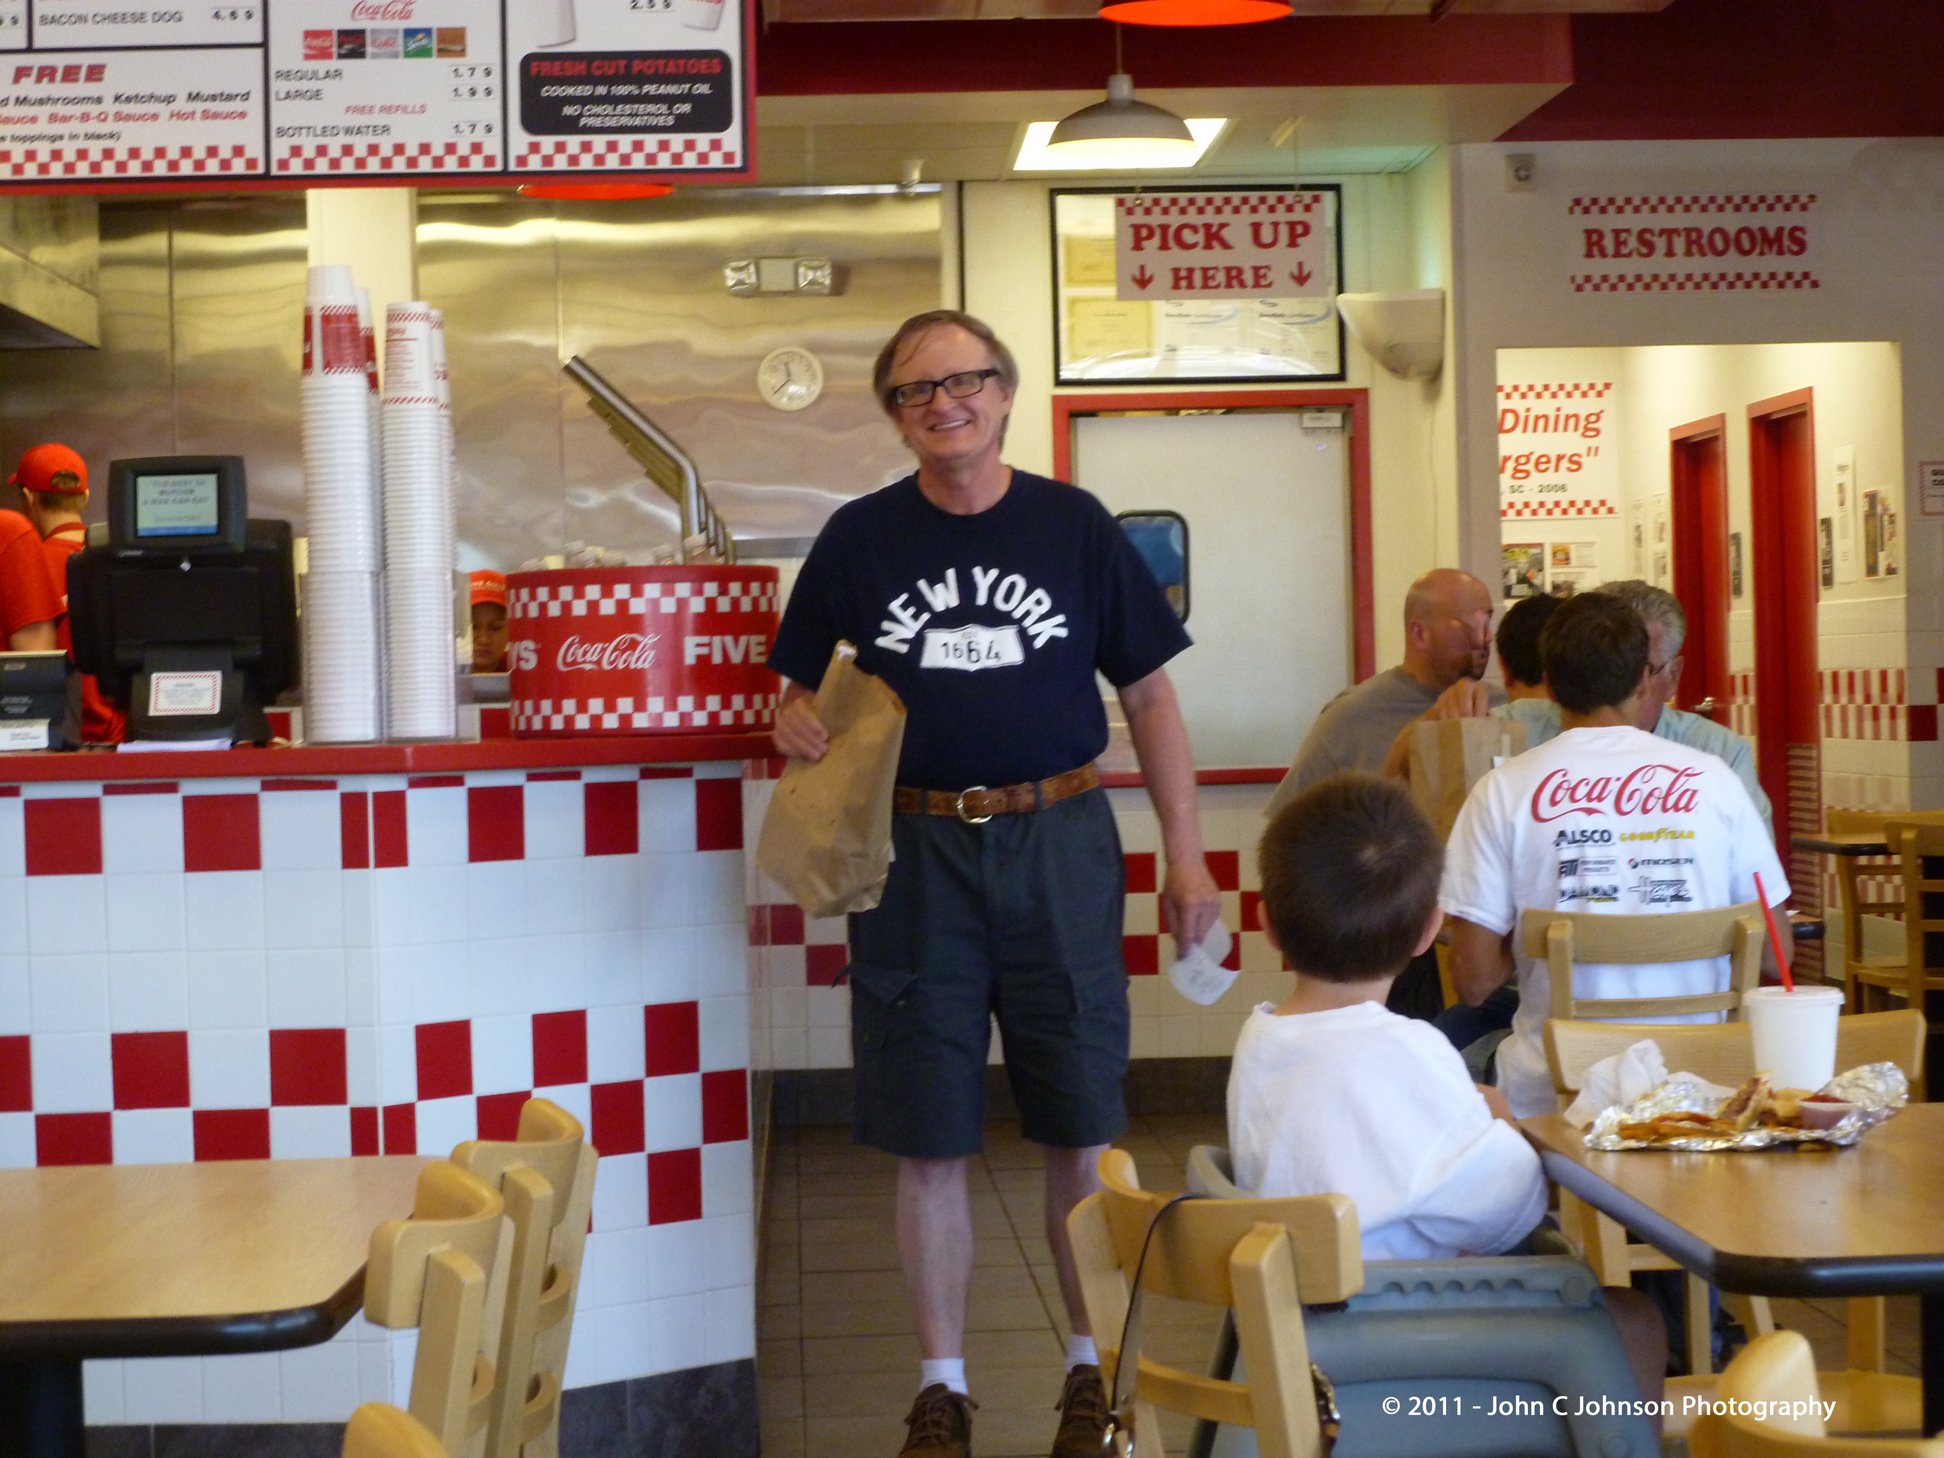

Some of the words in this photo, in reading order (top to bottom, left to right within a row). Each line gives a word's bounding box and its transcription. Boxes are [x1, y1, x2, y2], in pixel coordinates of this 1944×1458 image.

[39, 13, 88, 26] BACON
[92, 11, 147, 25] CHEESE
[151, 10, 183, 23] DOG
[351, 0, 417, 21] Coca-Cola
[12, 63, 107, 85] FREE
[275, 68, 342, 82] REGULAR
[530, 60, 587, 76] FRESH
[591, 60, 628, 75] CUT
[632, 58, 723, 75] POTATOES
[14, 94, 103, 107] Mushrooms
[113, 91, 177, 106] Ketchup
[186, 90, 251, 103] Mustard
[275, 88, 324, 101] LARGE
[541, 85, 593, 97] COOKED
[594, 84, 608, 96] IN
[610, 84, 640, 96] 100%
[641, 83, 690, 95] PEANUT
[692, 83, 713, 95] OIL
[48, 111, 109, 124] Bar-B-Q
[113, 110, 160, 123] Sauce
[169, 109, 196, 121] Hot
[200, 109, 248, 121] Sauce
[345, 104, 375, 115] FREE
[379, 103, 427, 115] REFILLS
[562, 105, 582, 116] NO
[583, 103, 670, 116] CHOLESTEROL
[673, 103, 692, 114] OR
[579, 115, 675, 127] PRESERVATIVES
[10, 132, 64, 144] toppings
[68, 131, 80, 142] in
[275, 125, 339, 138] BOTTLED
[342, 124, 391, 137] WATER
[1130, 222, 1234, 251] PICK
[1249, 221, 1312, 249] UP
[1582, 225, 1808, 259] RESTROOMS
[1170, 265, 1273, 290] HERE
[1499, 407, 1605, 439] Dining
[874, 567, 960, 654] NEW
[971, 565, 1069, 649] YORK
[557, 633, 662, 671] Coca-Cola
[684, 635, 768, 665] FIVE
[941, 640, 1002, 664] 1664
[1531, 764, 1706, 823] Coca-Cola
[1553, 829, 1612, 847] ALSCO
